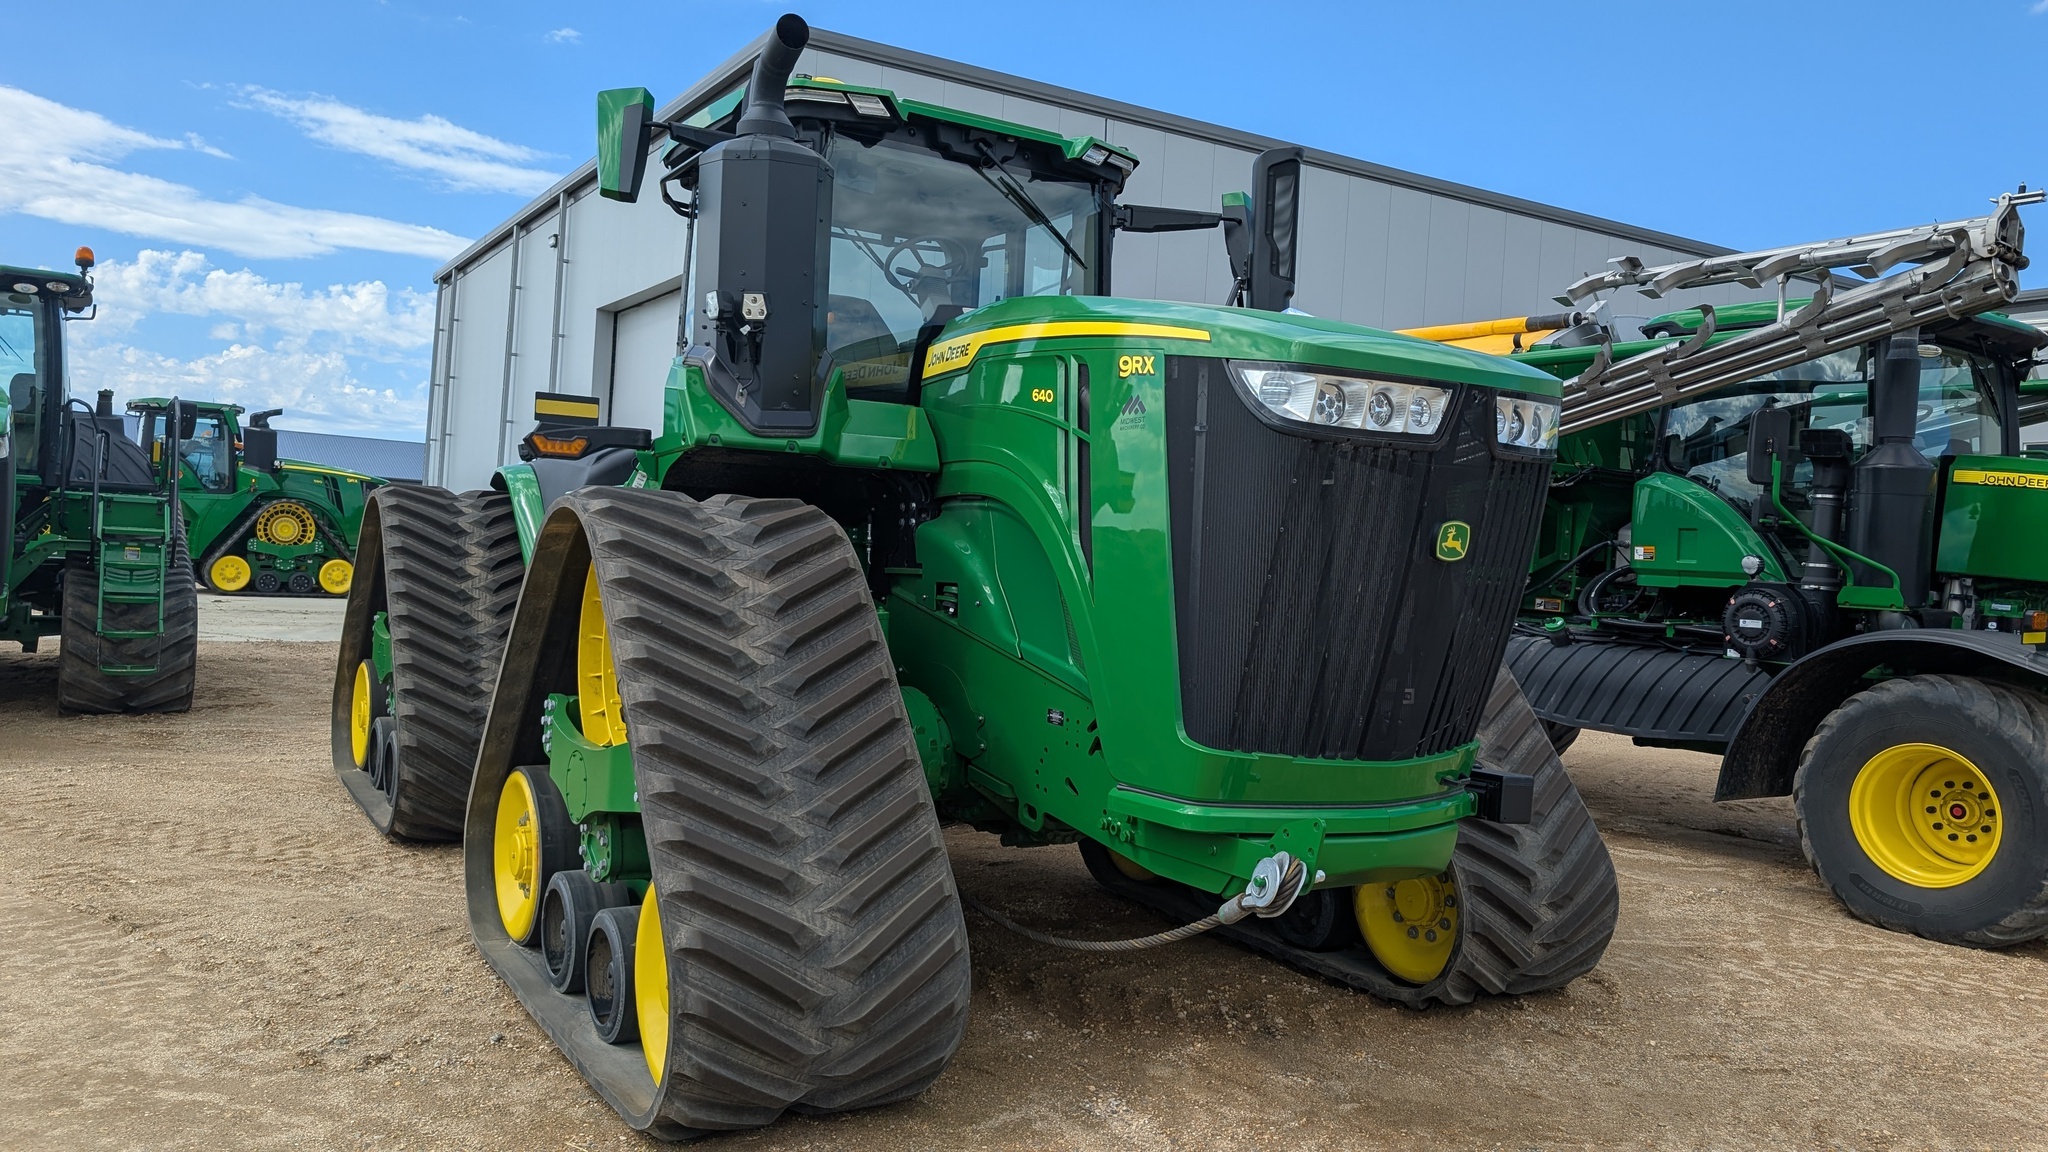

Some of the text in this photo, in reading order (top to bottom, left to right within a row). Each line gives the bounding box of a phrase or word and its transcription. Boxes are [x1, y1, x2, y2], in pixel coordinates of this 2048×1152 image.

[928, 342, 971, 368] JOHN DEERE
[1119, 355, 1155, 378] 9RX
[1032, 388, 1054, 403] 640
[1120, 416, 1146, 425] MIDWEST
[1980, 473, 2016, 486] JOHN
